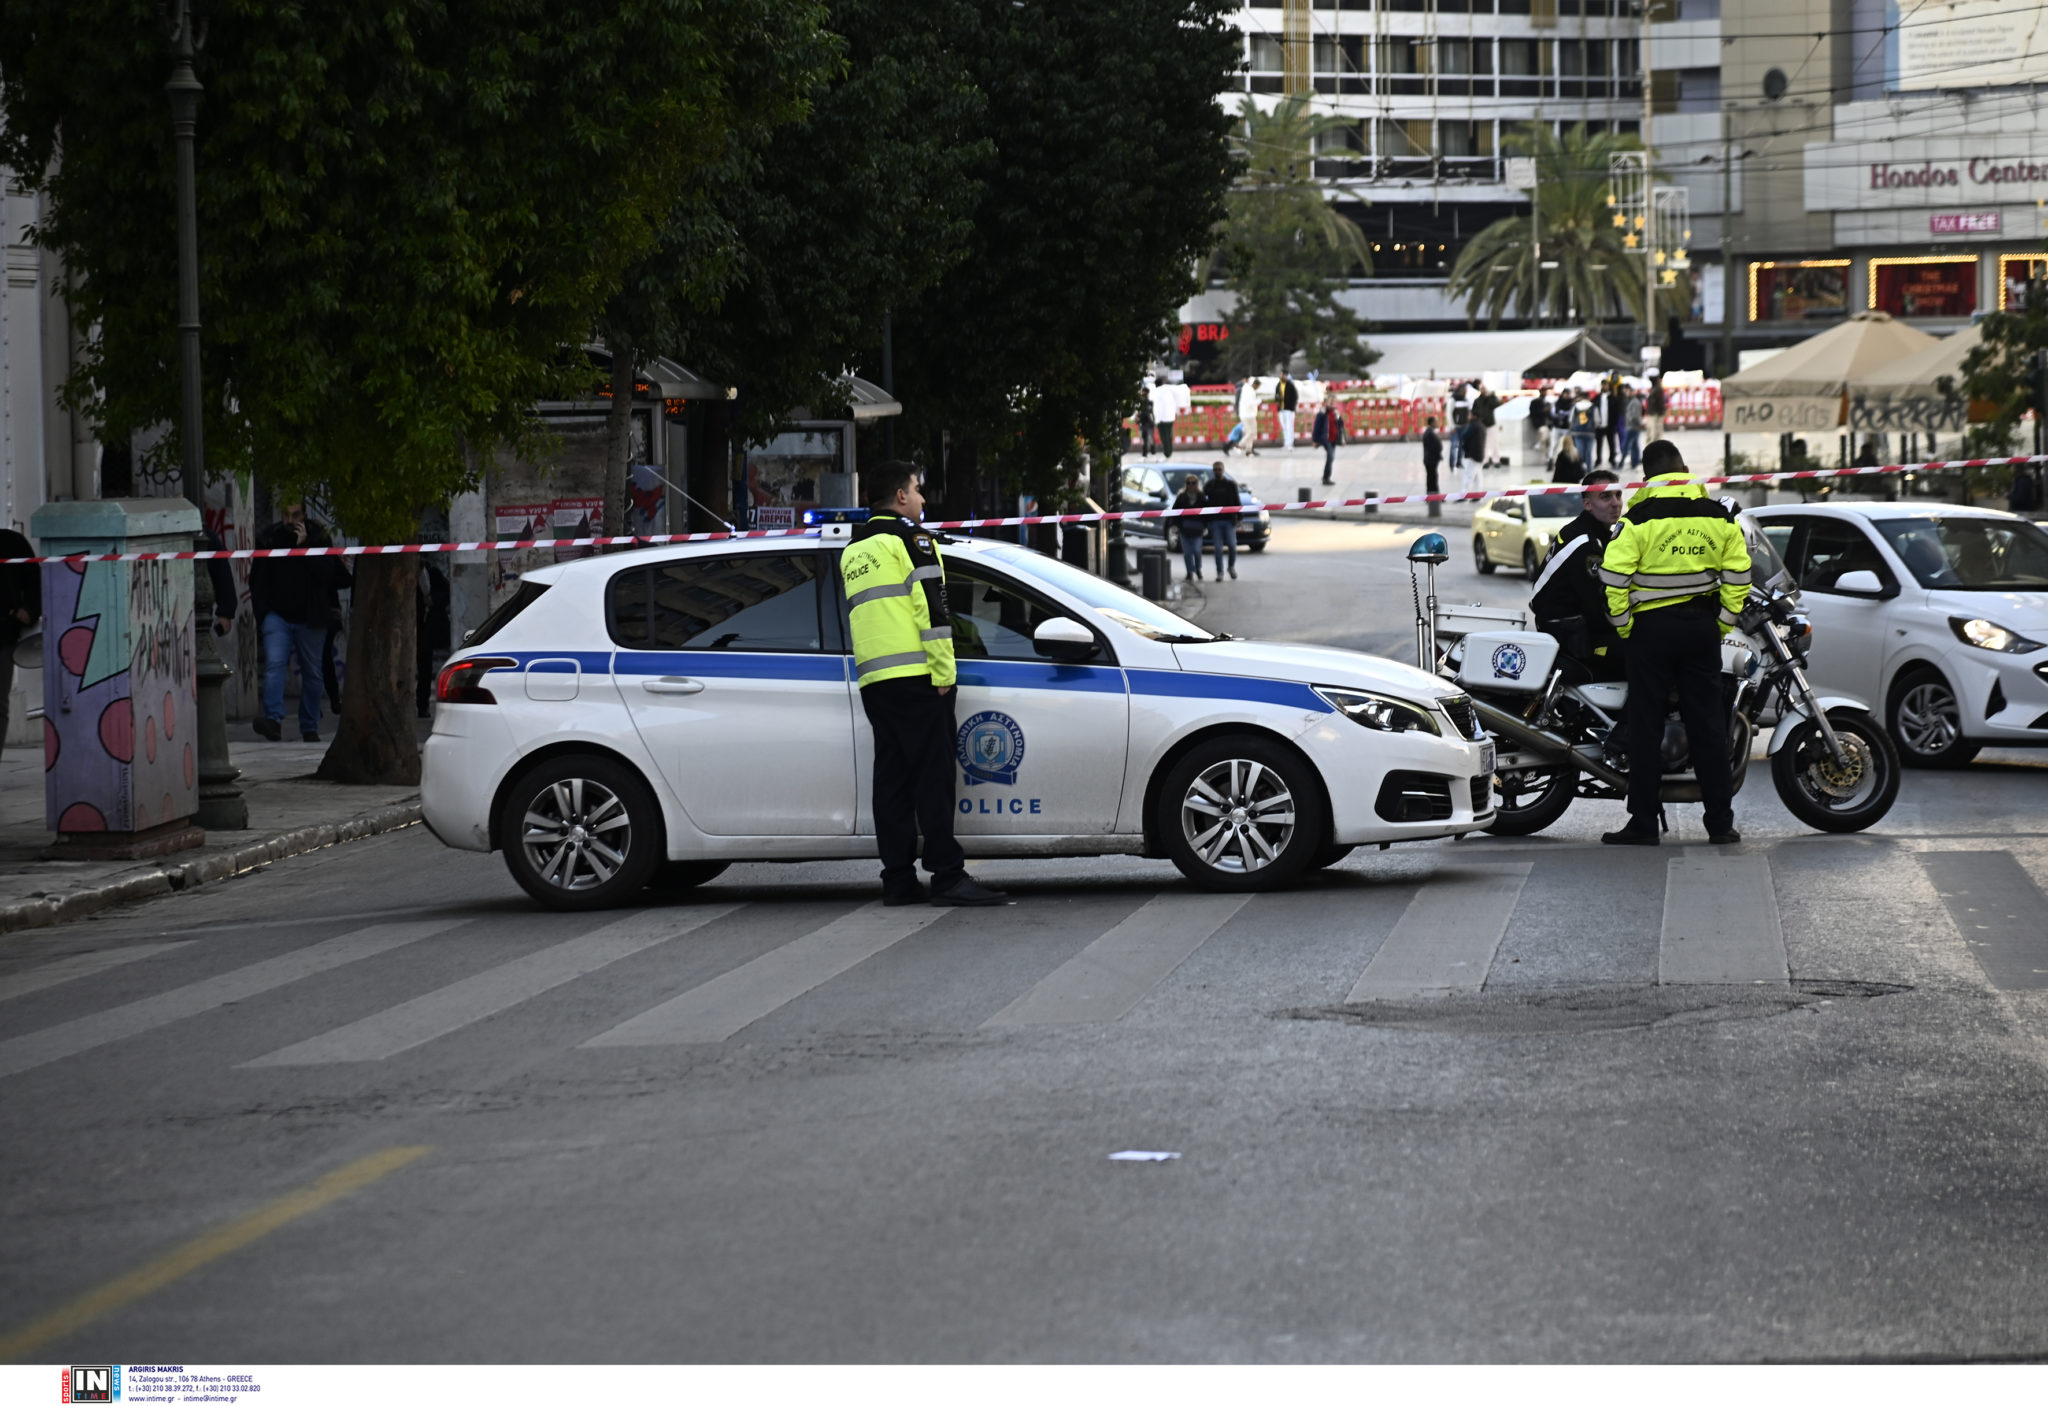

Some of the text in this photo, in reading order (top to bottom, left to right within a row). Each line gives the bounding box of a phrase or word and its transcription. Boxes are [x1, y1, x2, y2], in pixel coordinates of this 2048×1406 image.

[1870, 160, 1958, 189] Hondos
[1933, 213, 1997, 231] TAX FREE
[846, 563, 869, 582] POLICE
[957, 712, 1023, 767] ΕΛΛΗΝΙΚΗ ΑΣΤΥΝΟΜΙΑ
[958, 798, 1042, 814] OLICE
